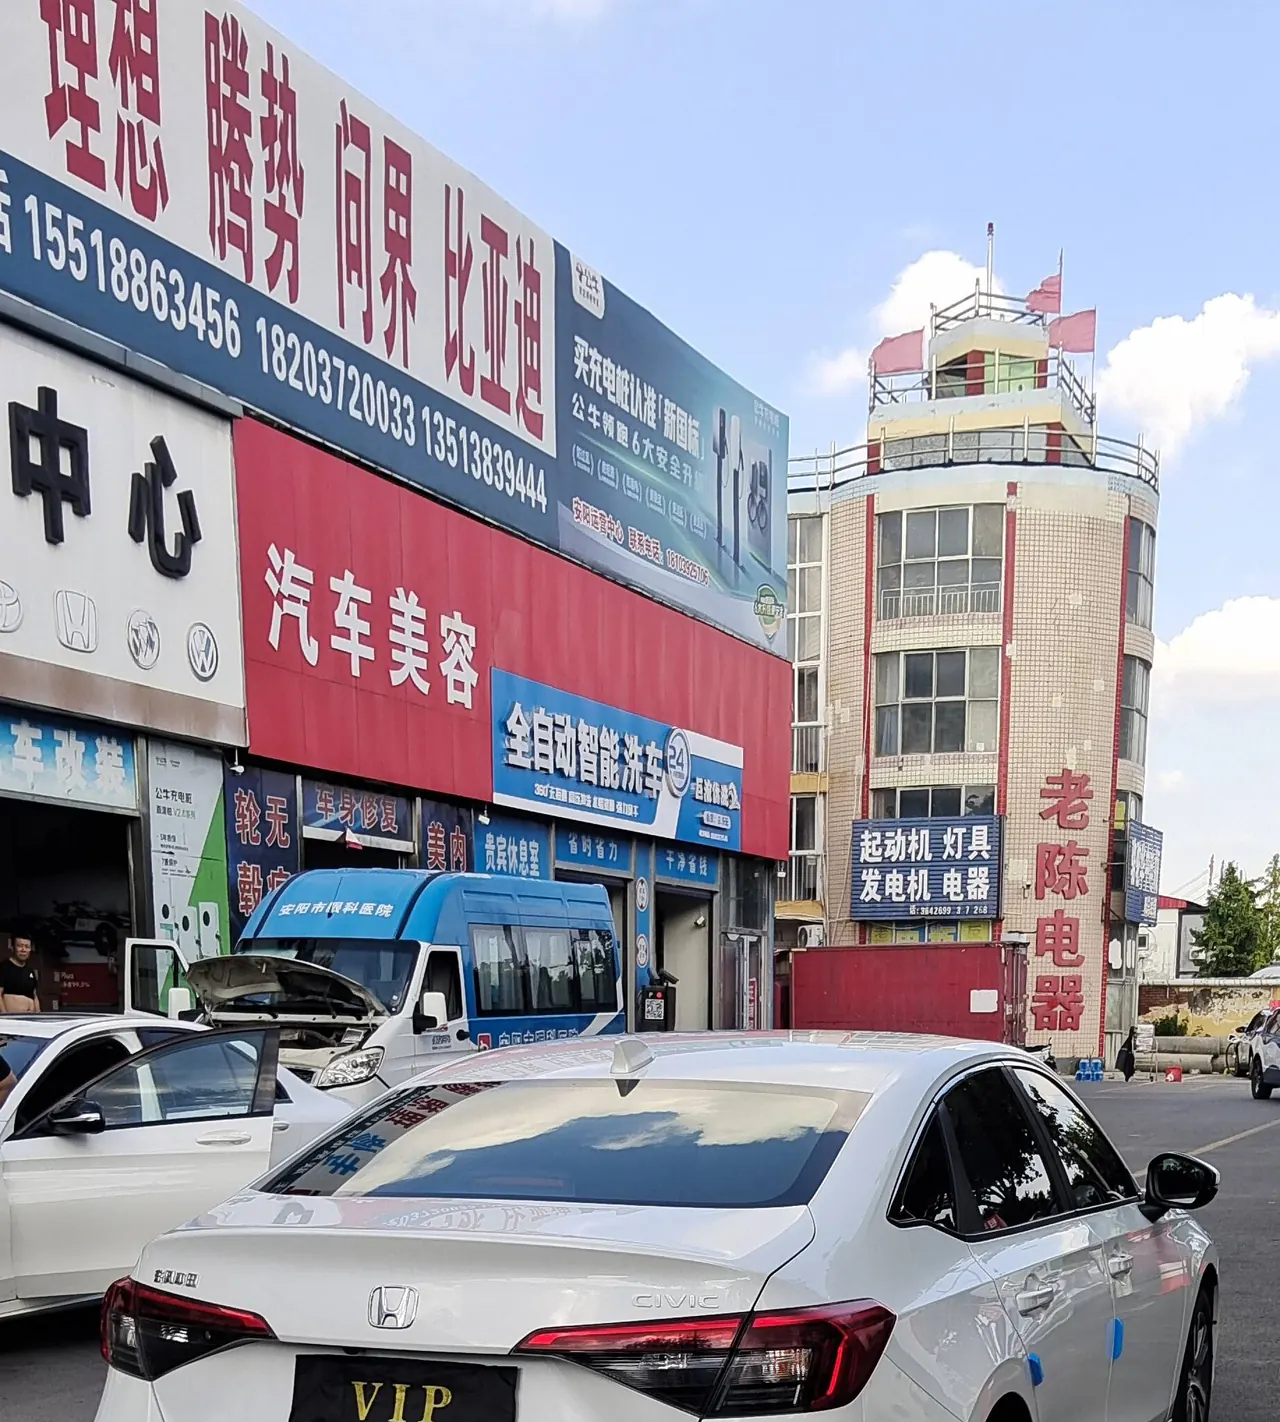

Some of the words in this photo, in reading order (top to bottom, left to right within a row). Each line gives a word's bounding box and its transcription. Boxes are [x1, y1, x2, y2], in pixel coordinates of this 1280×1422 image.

[40, 0, 169, 222] 理想
[205, 10, 304, 304] 腾势
[335, 97, 416, 369] 问界
[443, 184, 545, 442] 比亚迪
[24, 195, 241, 357] 15518863456
[256, 316, 416, 446] 18203720033
[422, 405, 547, 513] 13513839444
[8, 386, 202, 579] 中心
[265, 543, 479, 709] 汽车美容
[506, 701, 663, 798] 全自动智能洗车
[668, 745, 684, 772] 24
[316, 782, 398, 833] 车身修复
[427, 820, 446, 871] 美
[485, 832, 540, 877] 贵宾休息室
[568, 831, 618, 862] 省时省力
[860, 828, 932, 863] 起动机
[942, 825, 991, 860] 灯具
[279, 901, 393, 918] 安阳市眼科医院
[860, 867, 931, 902] 发电机
[943, 867, 989, 901] 电器
[1030, 769, 1094, 1031] 老陈电器
[632, 1293, 720, 1310] CIVIC
